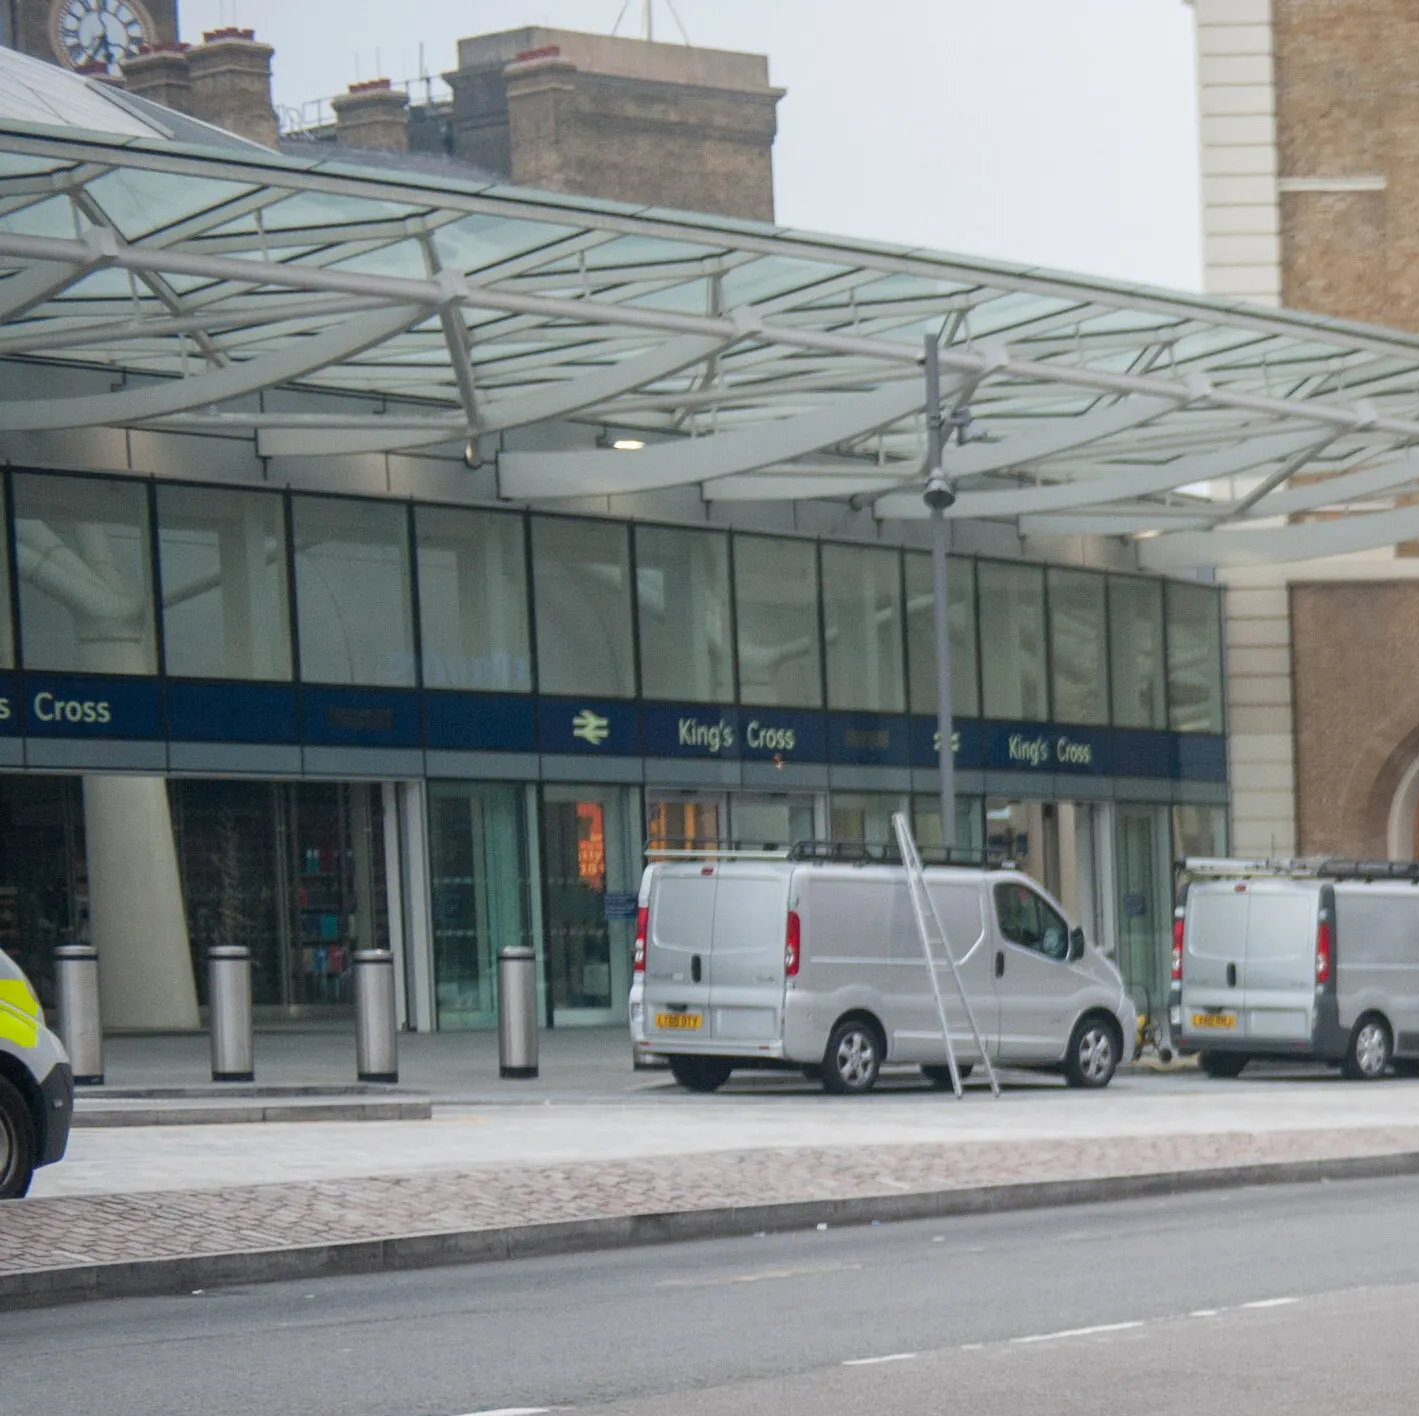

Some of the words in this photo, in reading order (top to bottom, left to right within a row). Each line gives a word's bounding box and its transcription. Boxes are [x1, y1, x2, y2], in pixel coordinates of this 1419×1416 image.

[33, 692, 111, 723] Cross
[679, 718, 734, 752] King's
[746, 720, 795, 750] Cross
[1009, 734, 1049, 766] King's
[1057, 736, 1091, 764] Cross
